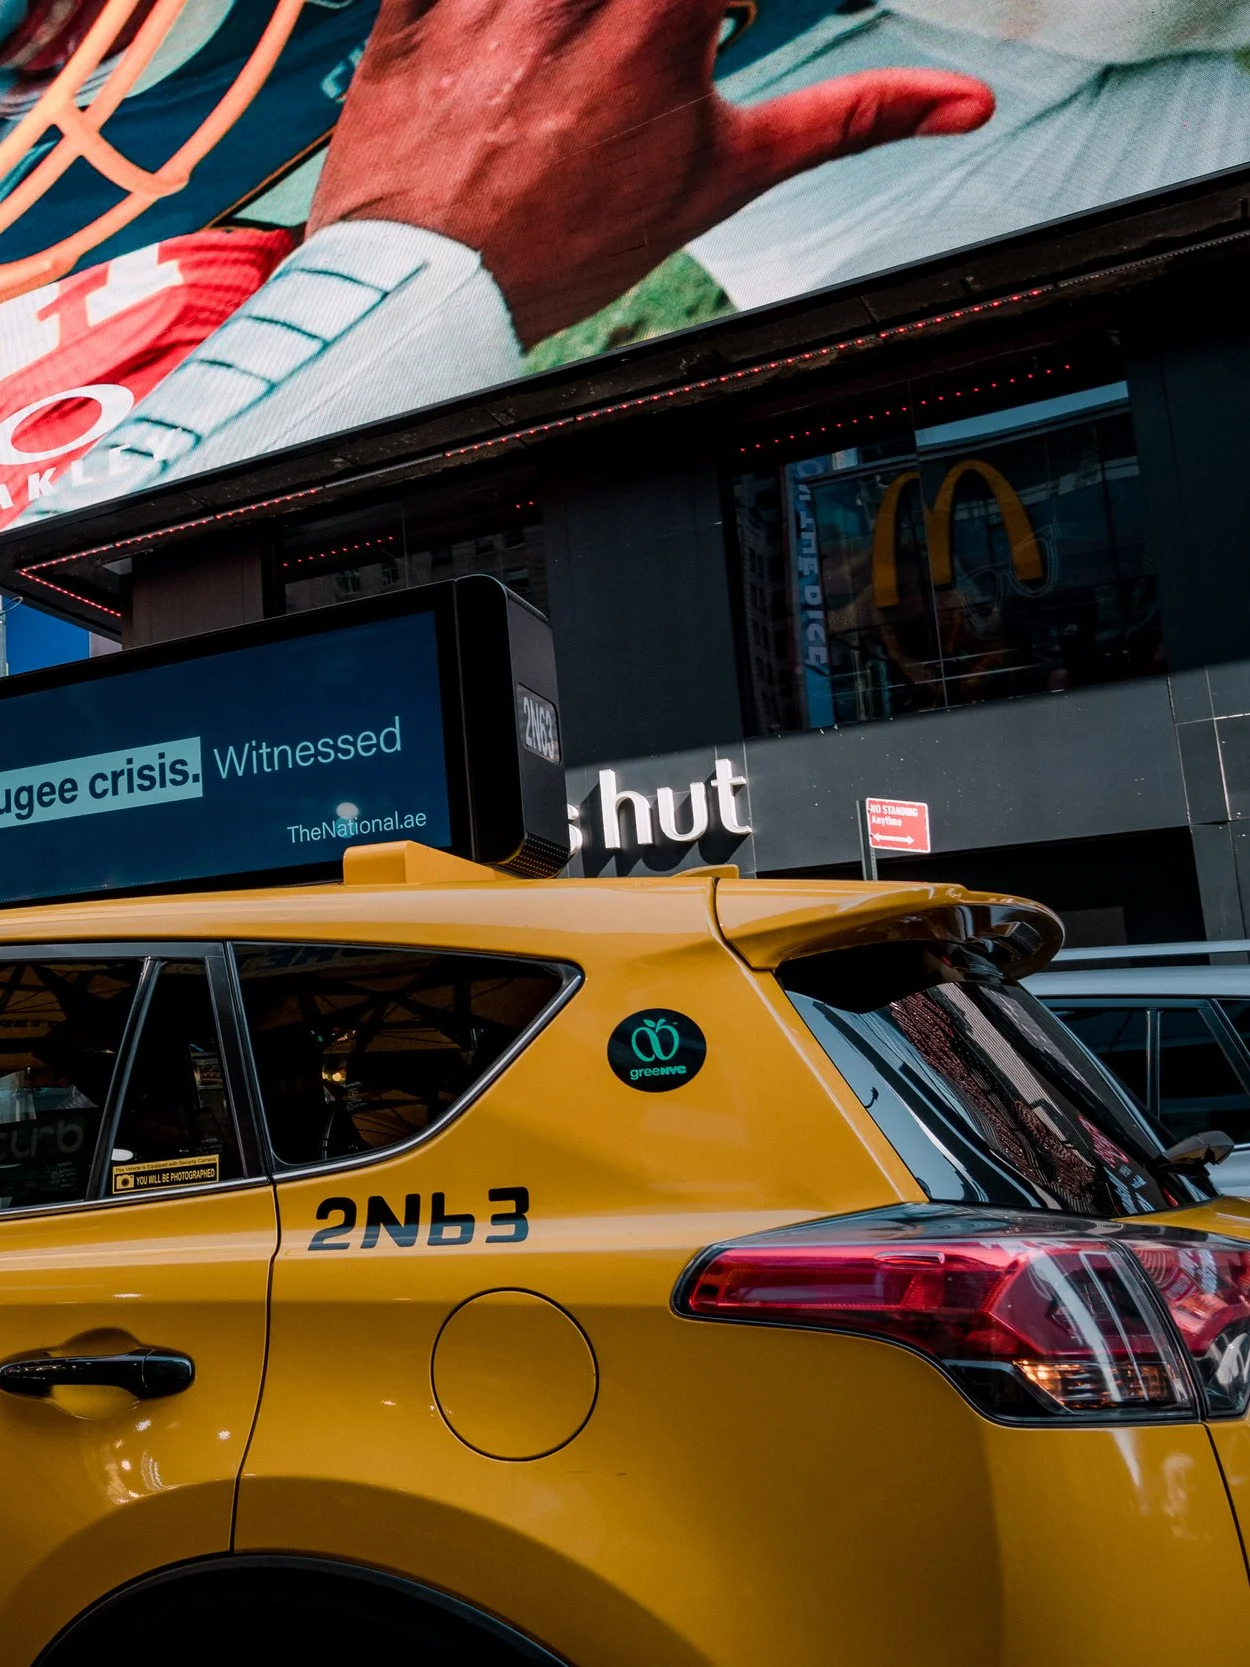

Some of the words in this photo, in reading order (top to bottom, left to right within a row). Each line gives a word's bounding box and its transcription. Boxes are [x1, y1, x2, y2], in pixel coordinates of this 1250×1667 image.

[523, 696, 554, 760] 2N63
[89, 751, 200, 800] crisis.
[214, 716, 403, 780] Witnessed
[599, 758, 752, 849] hut
[869, 804, 881, 814] NO
[882, 806, 918, 818] STANDING
[287, 810, 427, 844] TheNational.ae
[871, 815, 902, 827] Anytime
[136, 1176, 148, 1186] YOU
[148, 1174, 161, 1185] WILL
[162, 1173, 170, 1183] BE
[171, 1168, 215, 1182] PHOTOGRAPHED
[147, 1162, 168, 1170] Equipped
[179, 1159, 197, 1167] Security
